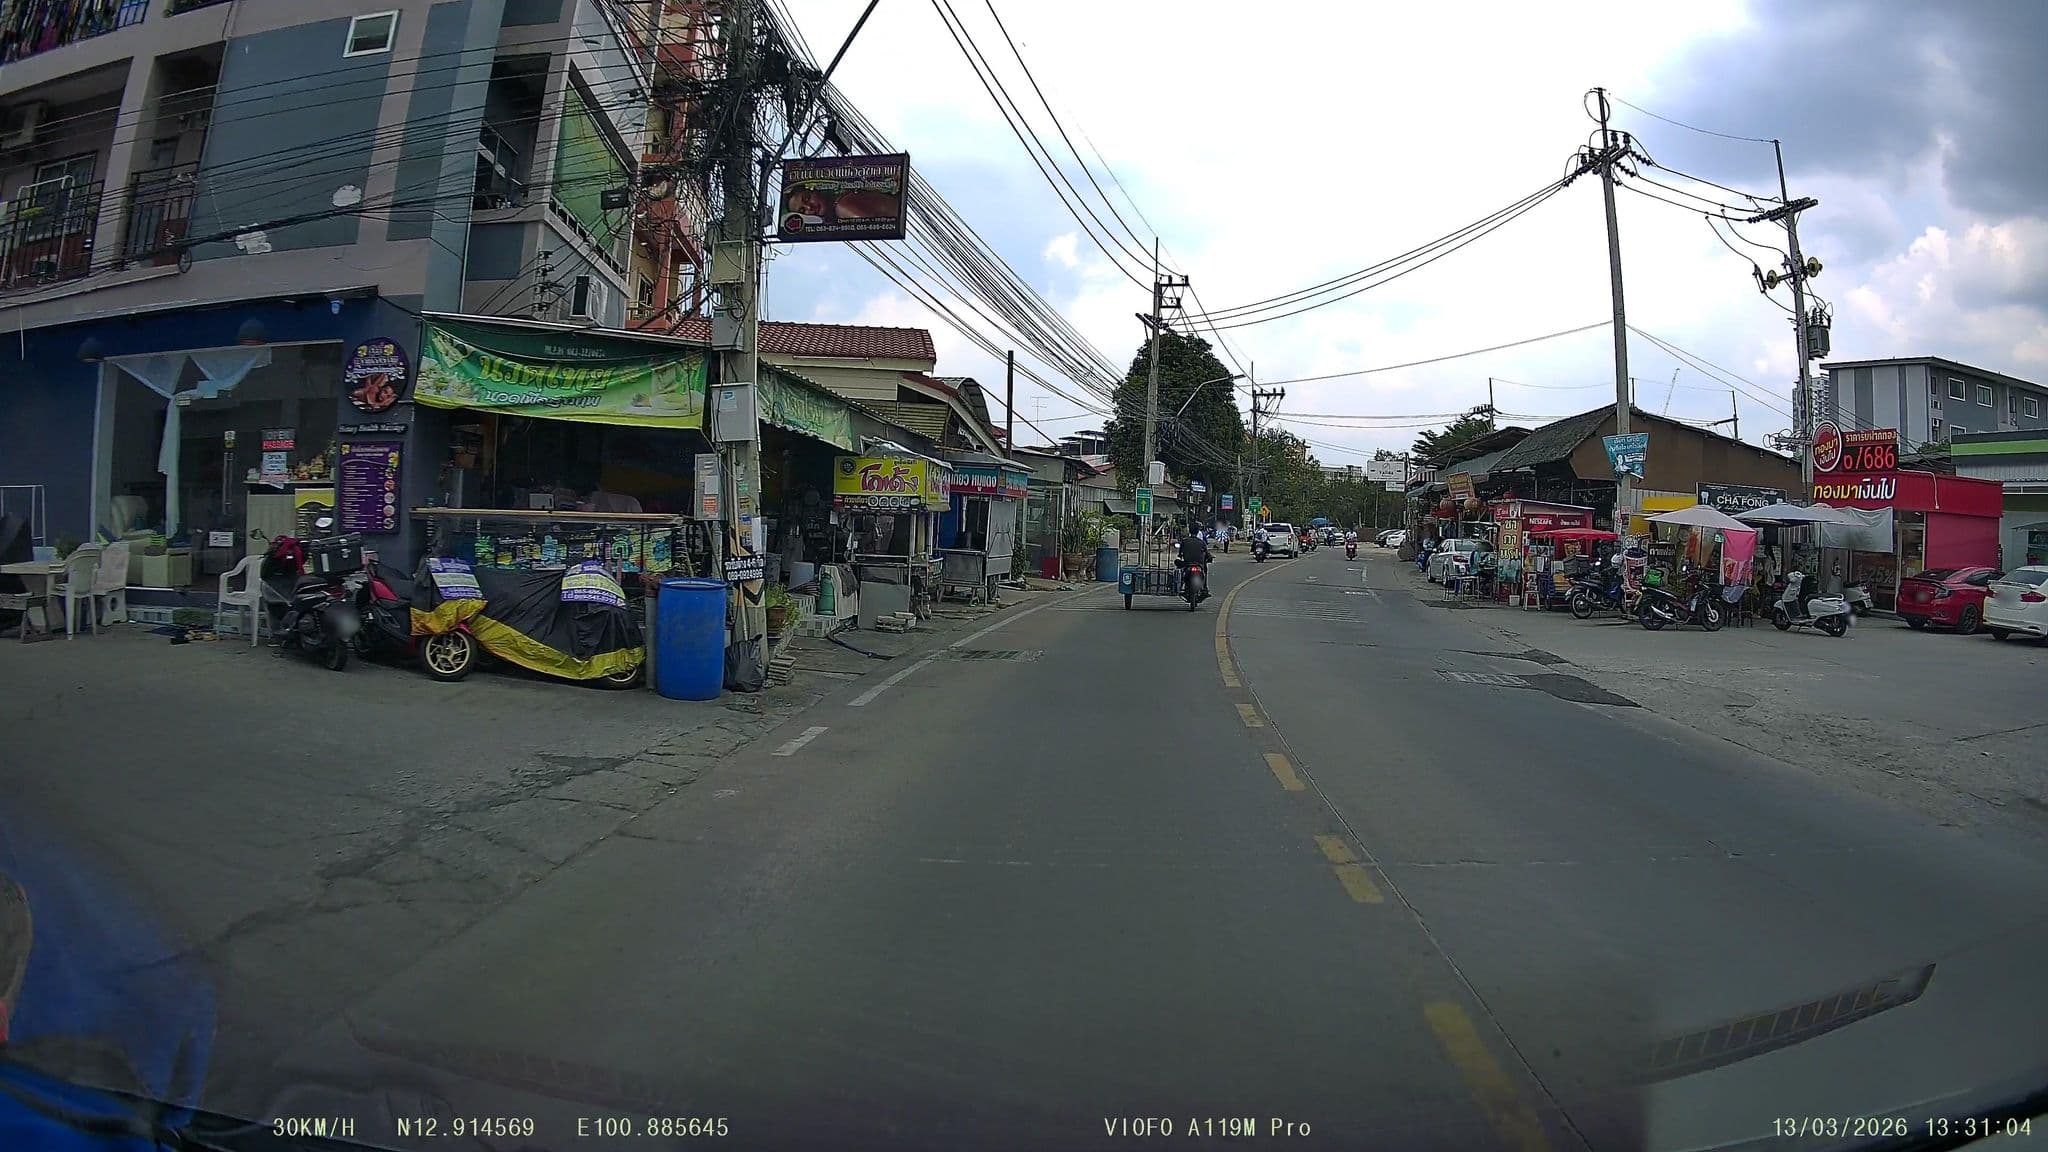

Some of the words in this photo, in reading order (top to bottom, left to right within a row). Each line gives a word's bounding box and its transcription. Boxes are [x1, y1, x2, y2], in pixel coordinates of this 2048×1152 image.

[480, 355, 613, 391] นวดไทย
[1813, 478, 1896, 499] ทองมาเงินไป
[1717, 495, 1740, 506] CHA
[1742, 498, 1769, 508] FONG
